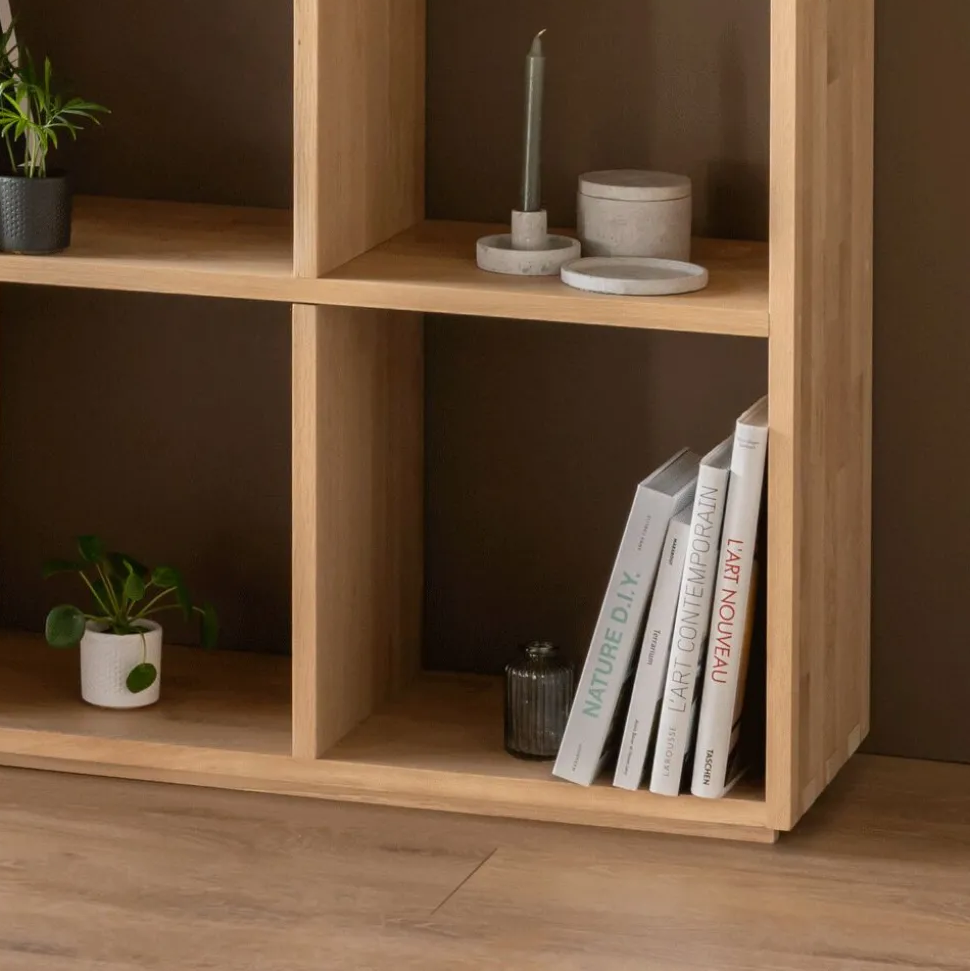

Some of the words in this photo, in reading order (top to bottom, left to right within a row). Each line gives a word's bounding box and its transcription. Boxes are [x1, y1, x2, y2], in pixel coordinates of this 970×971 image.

[676, 485, 719, 652] CONTEMPORAIN
[722, 538, 745, 584] L'ART
[582, 627, 624, 718] NATURE
[610, 570, 641, 624] D.I.Y.
[647, 629, 661, 666] Terrarium
[711, 588, 738, 684] NOUVEAU
[668, 657, 692, 712] L'ART
[662, 726, 677, 778] LAROUSSE
[702, 749, 714, 786] TASCHEN
